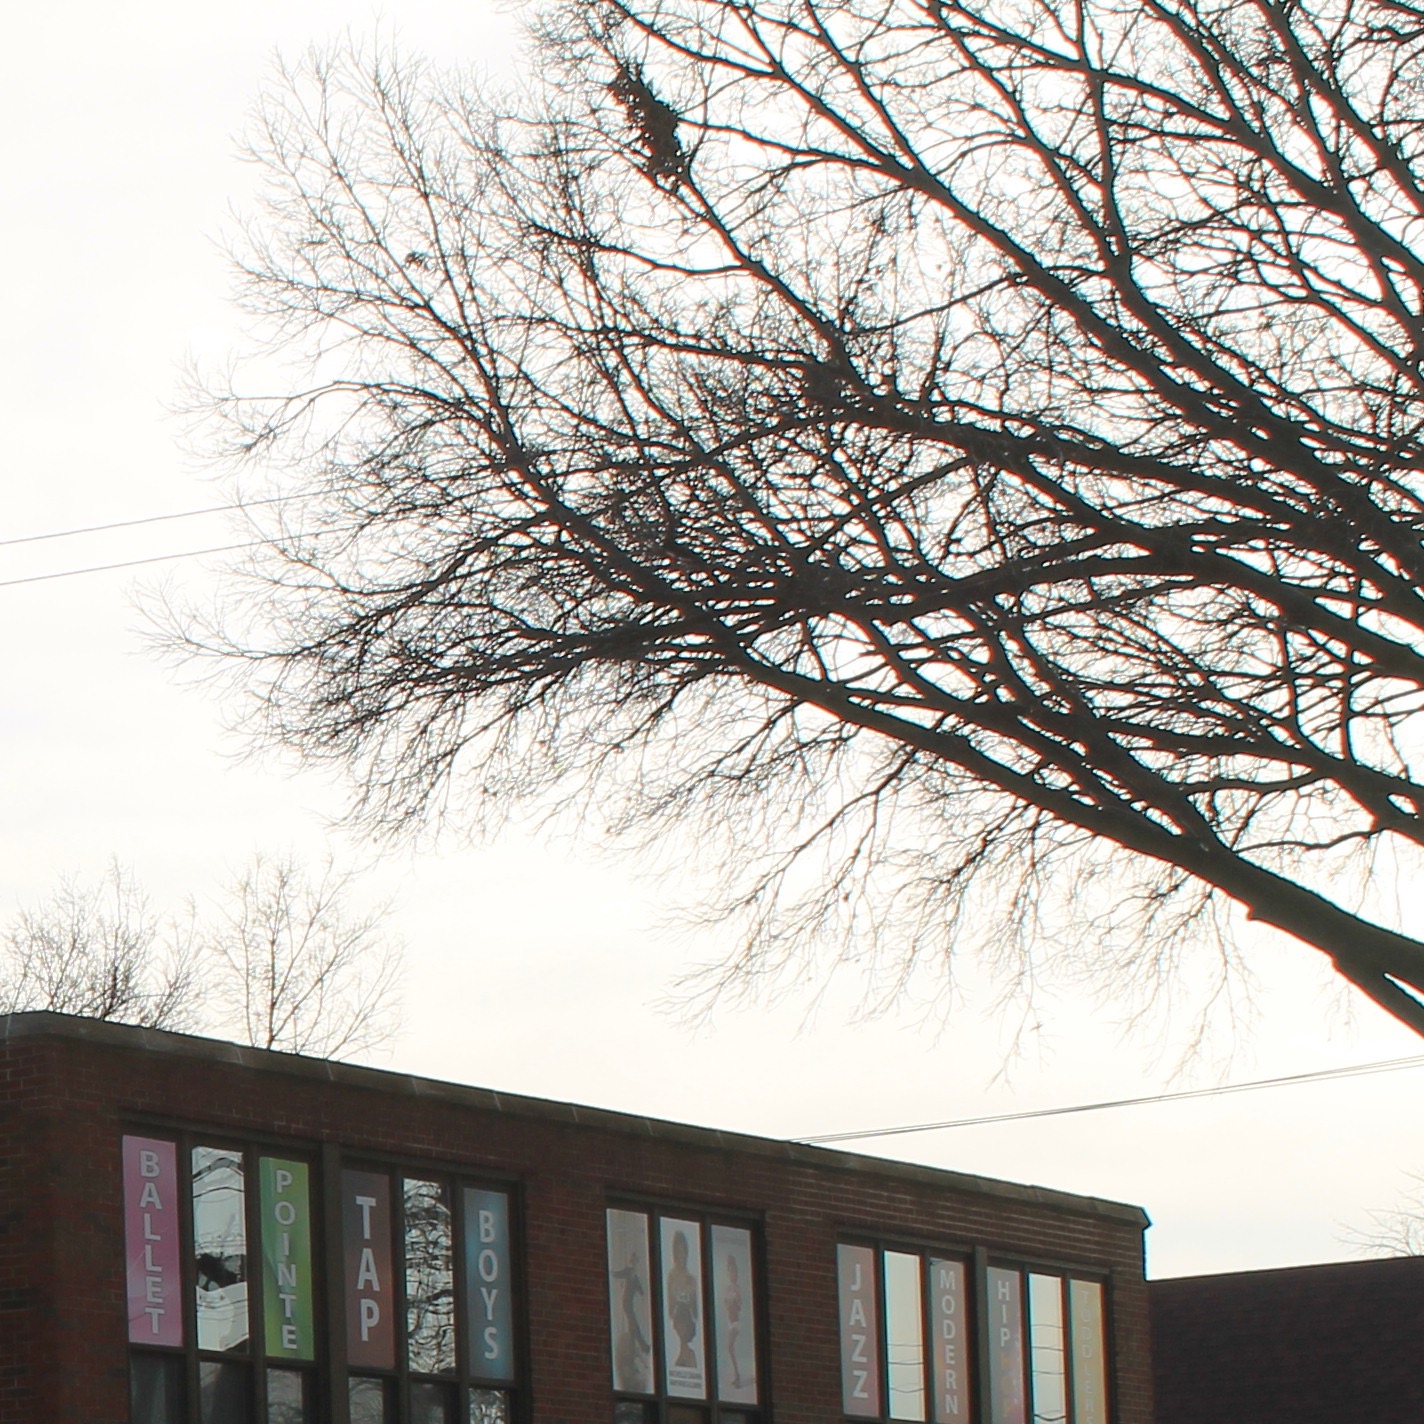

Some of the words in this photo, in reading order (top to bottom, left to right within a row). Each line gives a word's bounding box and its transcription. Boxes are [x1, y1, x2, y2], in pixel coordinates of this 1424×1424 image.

[138, 1150, 164, 1335] BALLET
[274, 1169, 298, 1350] POINTE
[355, 1196, 380, 1342] TAP
[478, 1209, 498, 1360] BOYS
[997, 1280, 1011, 1347] HIP
[849, 1263, 869, 1399] JAZZ
[940, 1269, 958, 1415] MODERN
